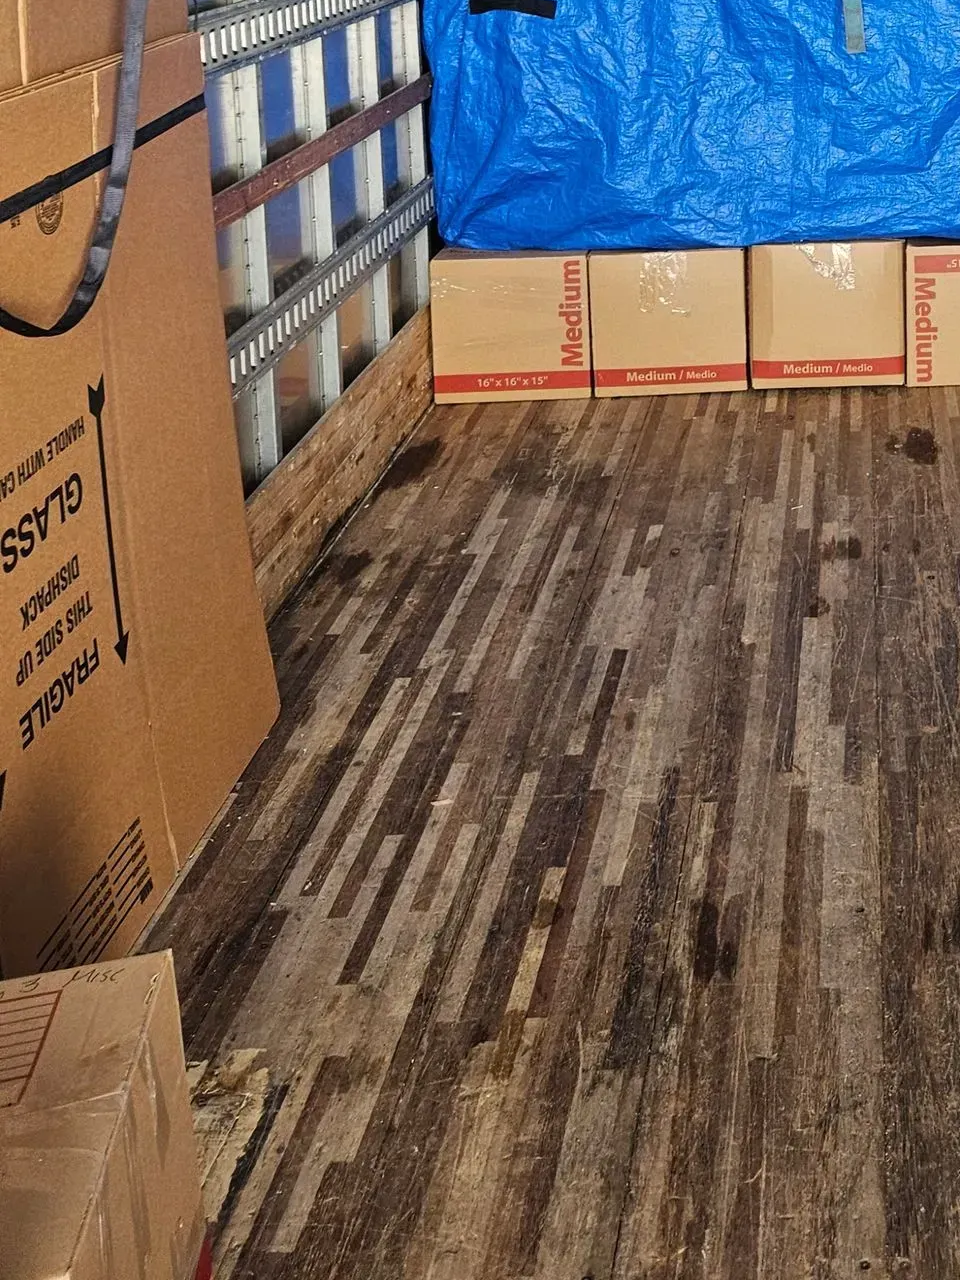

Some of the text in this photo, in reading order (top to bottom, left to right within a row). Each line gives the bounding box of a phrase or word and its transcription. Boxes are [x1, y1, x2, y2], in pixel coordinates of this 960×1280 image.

[558, 260, 584, 367] Medium
[914, 277, 938, 383] Medium
[477, 378, 494, 387] 16"
[495, 379, 502, 387] x
[504, 377, 521, 386] 16"
[531, 376, 548, 385] 15"
[626, 369, 717, 383] Medium / Medio
[783, 362, 873, 375] Medium / Medio
[0, 415, 85, 503] HANDLE WITH CA
[0, 472, 83, 574] GLASS
[16, 590, 94, 687] THIS SIDE UP
[19, 554, 80, 632] DISHPACK
[19, 637, 101, 751] FRAGILE
